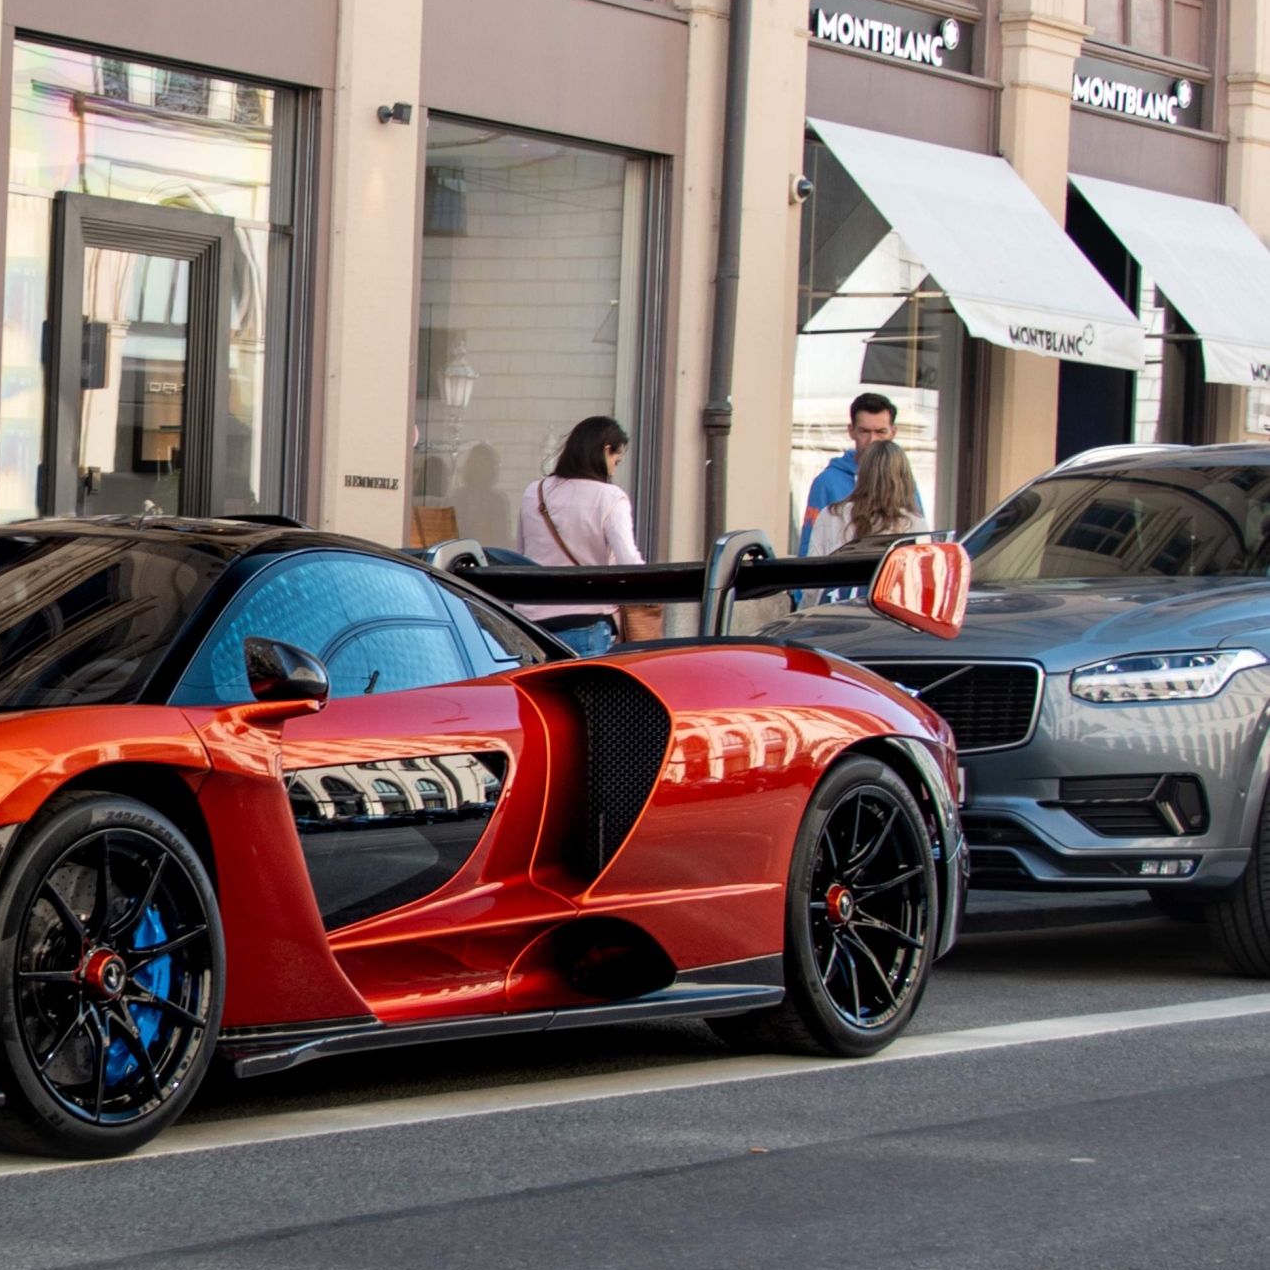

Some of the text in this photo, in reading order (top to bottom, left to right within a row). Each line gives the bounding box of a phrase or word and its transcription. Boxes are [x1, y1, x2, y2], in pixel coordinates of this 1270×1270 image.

[816, 7, 944, 67] MONTBLANC
[1073, 73, 1178, 124] MONTBLANC
[1009, 325, 1084, 356] MONTBLANC
[343, 474, 399, 490] HEMMERLE
